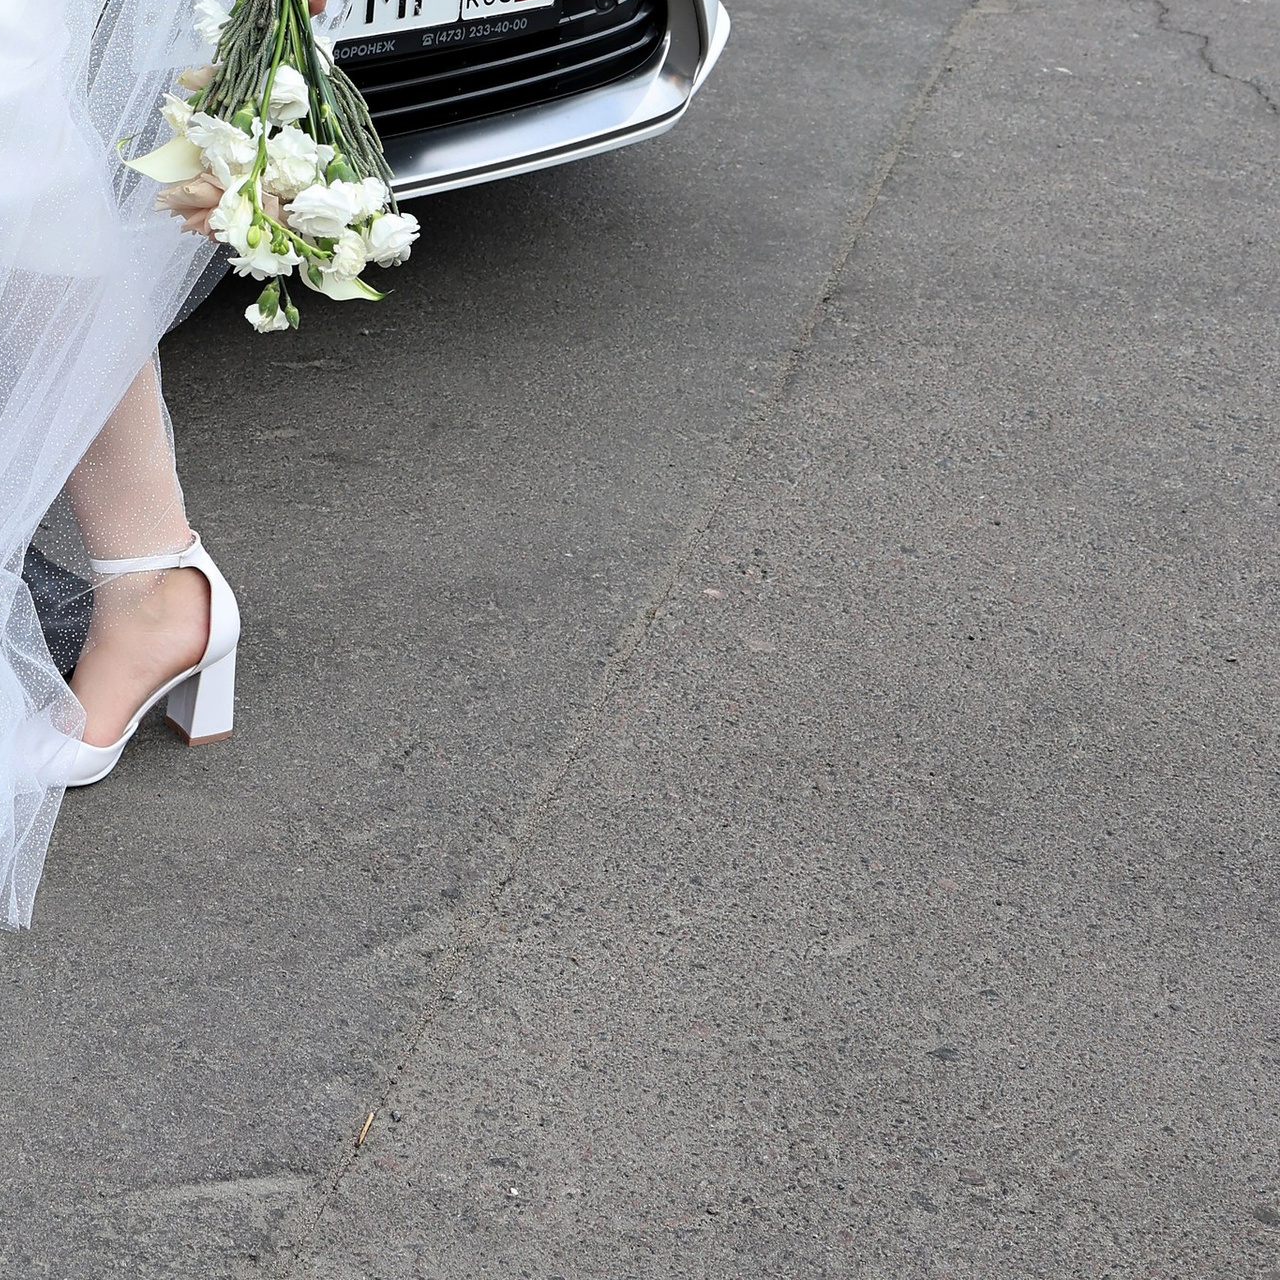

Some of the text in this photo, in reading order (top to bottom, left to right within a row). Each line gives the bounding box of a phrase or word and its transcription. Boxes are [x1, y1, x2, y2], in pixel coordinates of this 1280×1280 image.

[333, 18, 528, 60] ВОРОНЕЖ (473) 233-40-00
